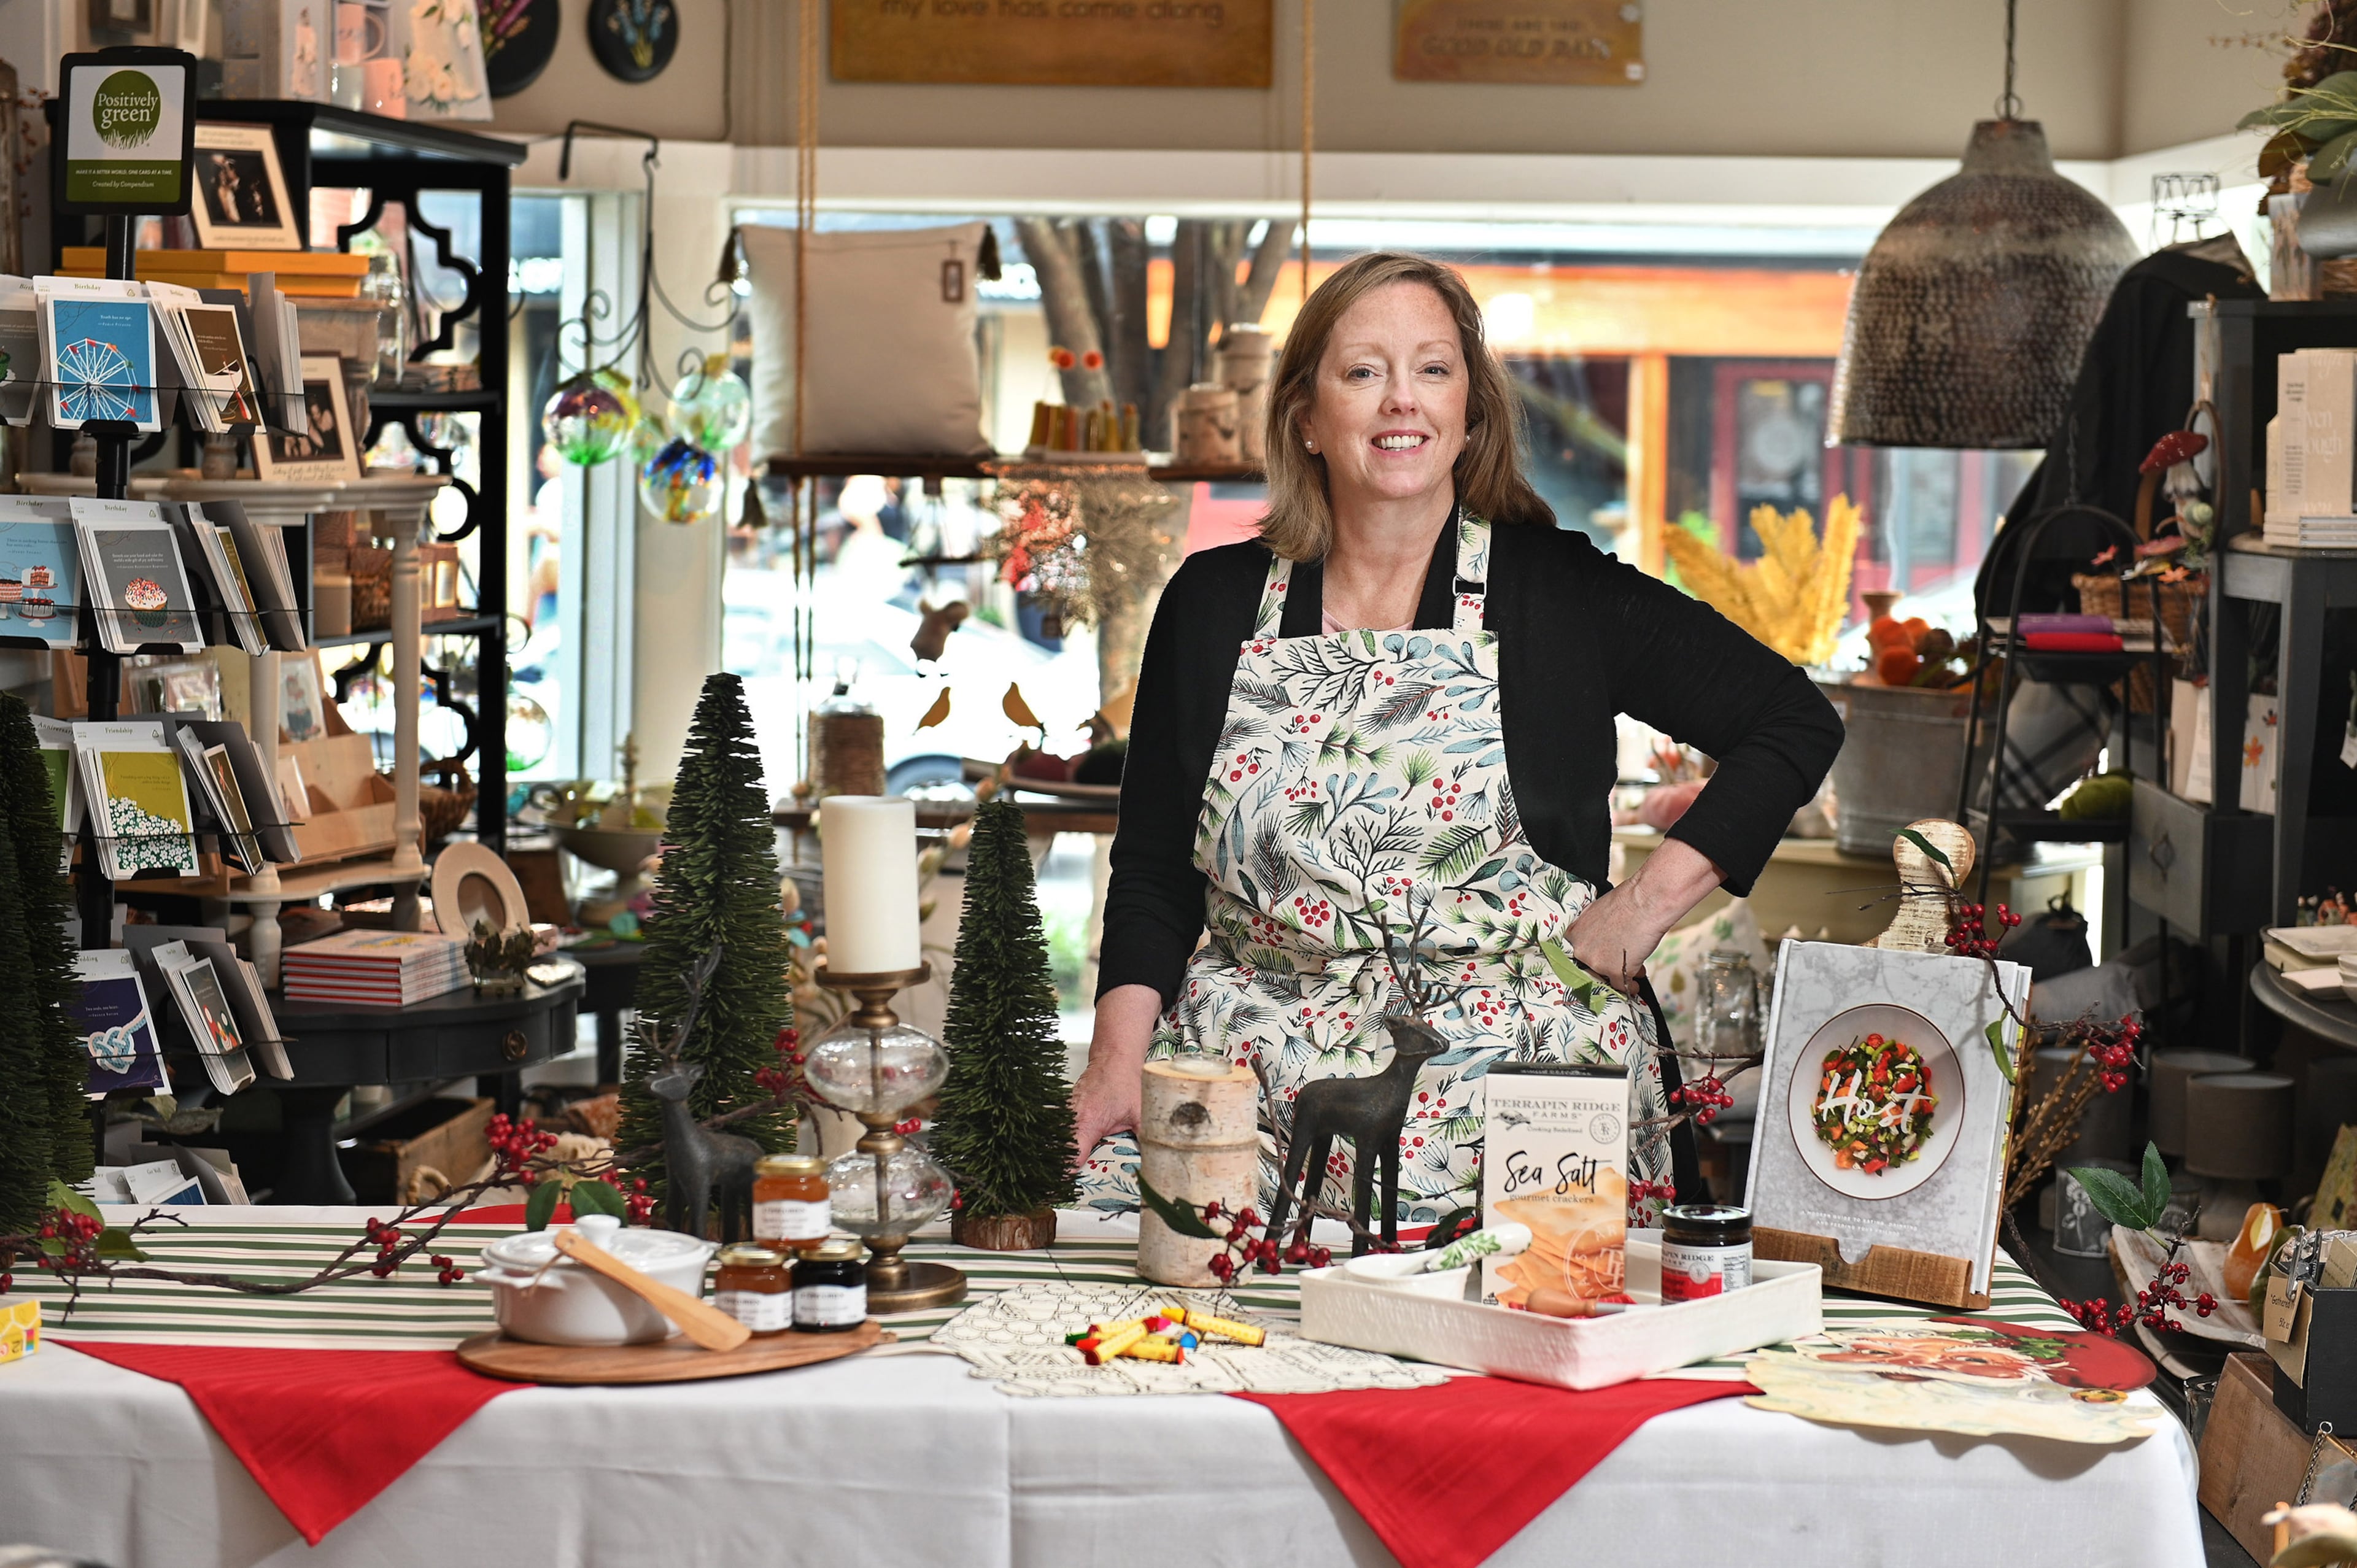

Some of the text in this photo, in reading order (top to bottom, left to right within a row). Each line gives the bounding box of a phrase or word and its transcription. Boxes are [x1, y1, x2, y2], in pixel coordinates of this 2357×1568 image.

[98, 91, 158, 111] Positively
[101, 108, 152, 129] green
[120, 180, 154, 189] Compendium
[74, 283, 101, 292] Birthday
[104, 504, 127, 513] Birthday
[37, 721, 74, 736] Anniversary
[1491, 1098, 1621, 1112] TERRAPIN RIDGE
[1817, 1068, 1933, 1134] Host
[1504, 1150, 1612, 1195] Sea Salt
[1509, 1194, 1595, 1204] gourmet crackers
[1830, 1222, 1856, 1230] FEEDING
[1681, 1253, 1714, 1262] RIDGE
